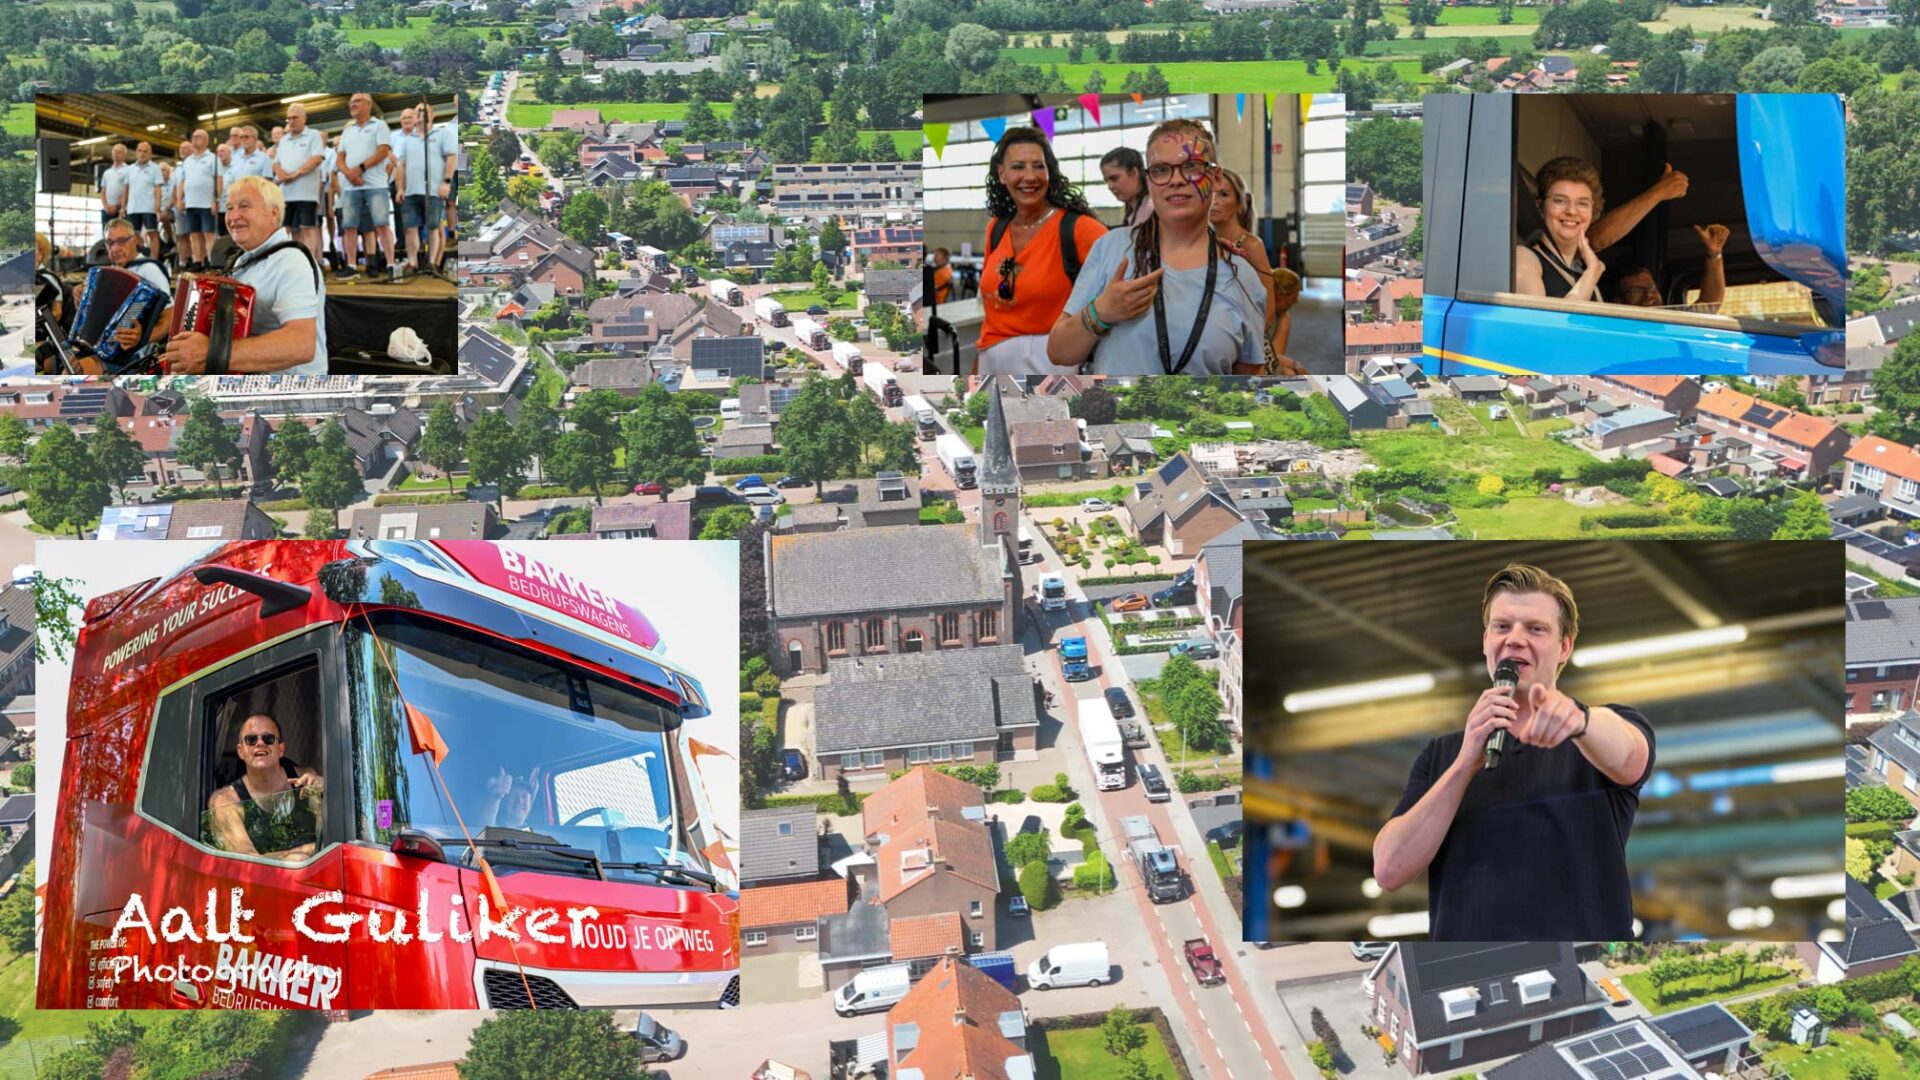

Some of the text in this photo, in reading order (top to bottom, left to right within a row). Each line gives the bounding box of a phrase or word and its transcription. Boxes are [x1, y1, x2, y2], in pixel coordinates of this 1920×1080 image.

[497, 544, 623, 620] BAKKER
[508, 574, 632, 638] BEDRIJFSWAGENS
[102, 623, 160, 674] POWERING
[163, 601, 198, 637] YOUR
[633, 925, 653, 950] JE
[654, 926, 677, 951] OP
[680, 928, 715, 952] WEG
